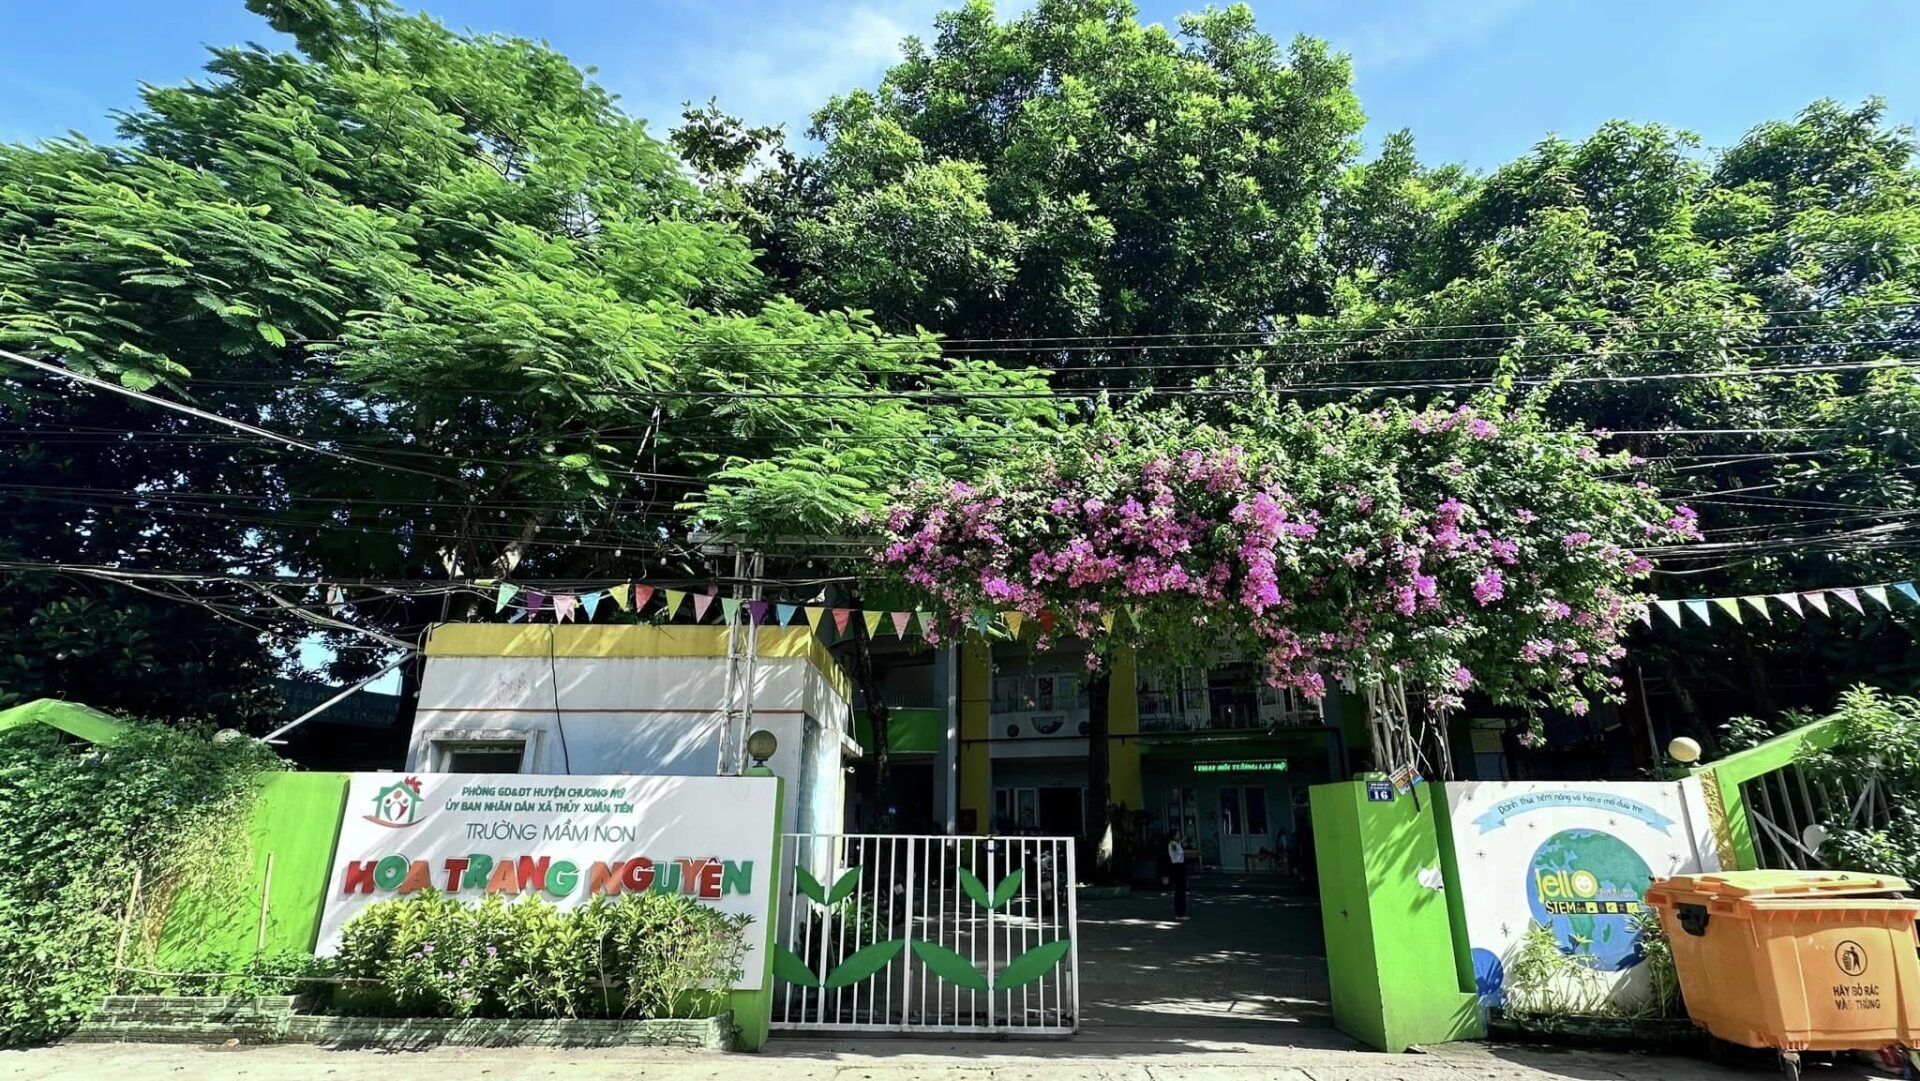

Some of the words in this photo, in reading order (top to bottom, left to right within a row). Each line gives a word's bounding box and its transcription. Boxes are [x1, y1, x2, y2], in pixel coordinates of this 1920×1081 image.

[461, 786, 495, 797] PHÒNG
[497, 786, 531, 797] GD&ĐT
[533, 785, 565, 799] HUYỆN
[567, 786, 608, 798] CHƯƠNG
[1374, 790, 1389, 800] 16
[445, 798, 460, 811] ỦY
[461, 801, 481, 811] BAN
[484, 800, 511, 812] NHÂN
[514, 800, 535, 812] DÂN
[538, 800, 552, 812] XÃ
[554, 799, 580, 813] THỦY
[583, 801, 610, 813] XUÂN
[466, 819, 537, 840] TRƯỜNG
[542, 818, 589, 842] MẦM
[593, 825, 636, 842] NON
[343, 853, 431, 894] HOA
[589, 856, 754, 900] NGUYÊN
[1545, 900, 1577, 914] STEM
[1833, 984, 1849, 996] HÃY
[1864, 984, 1879, 996] RÁC
[1835, 998, 1854, 1010] VÀ
